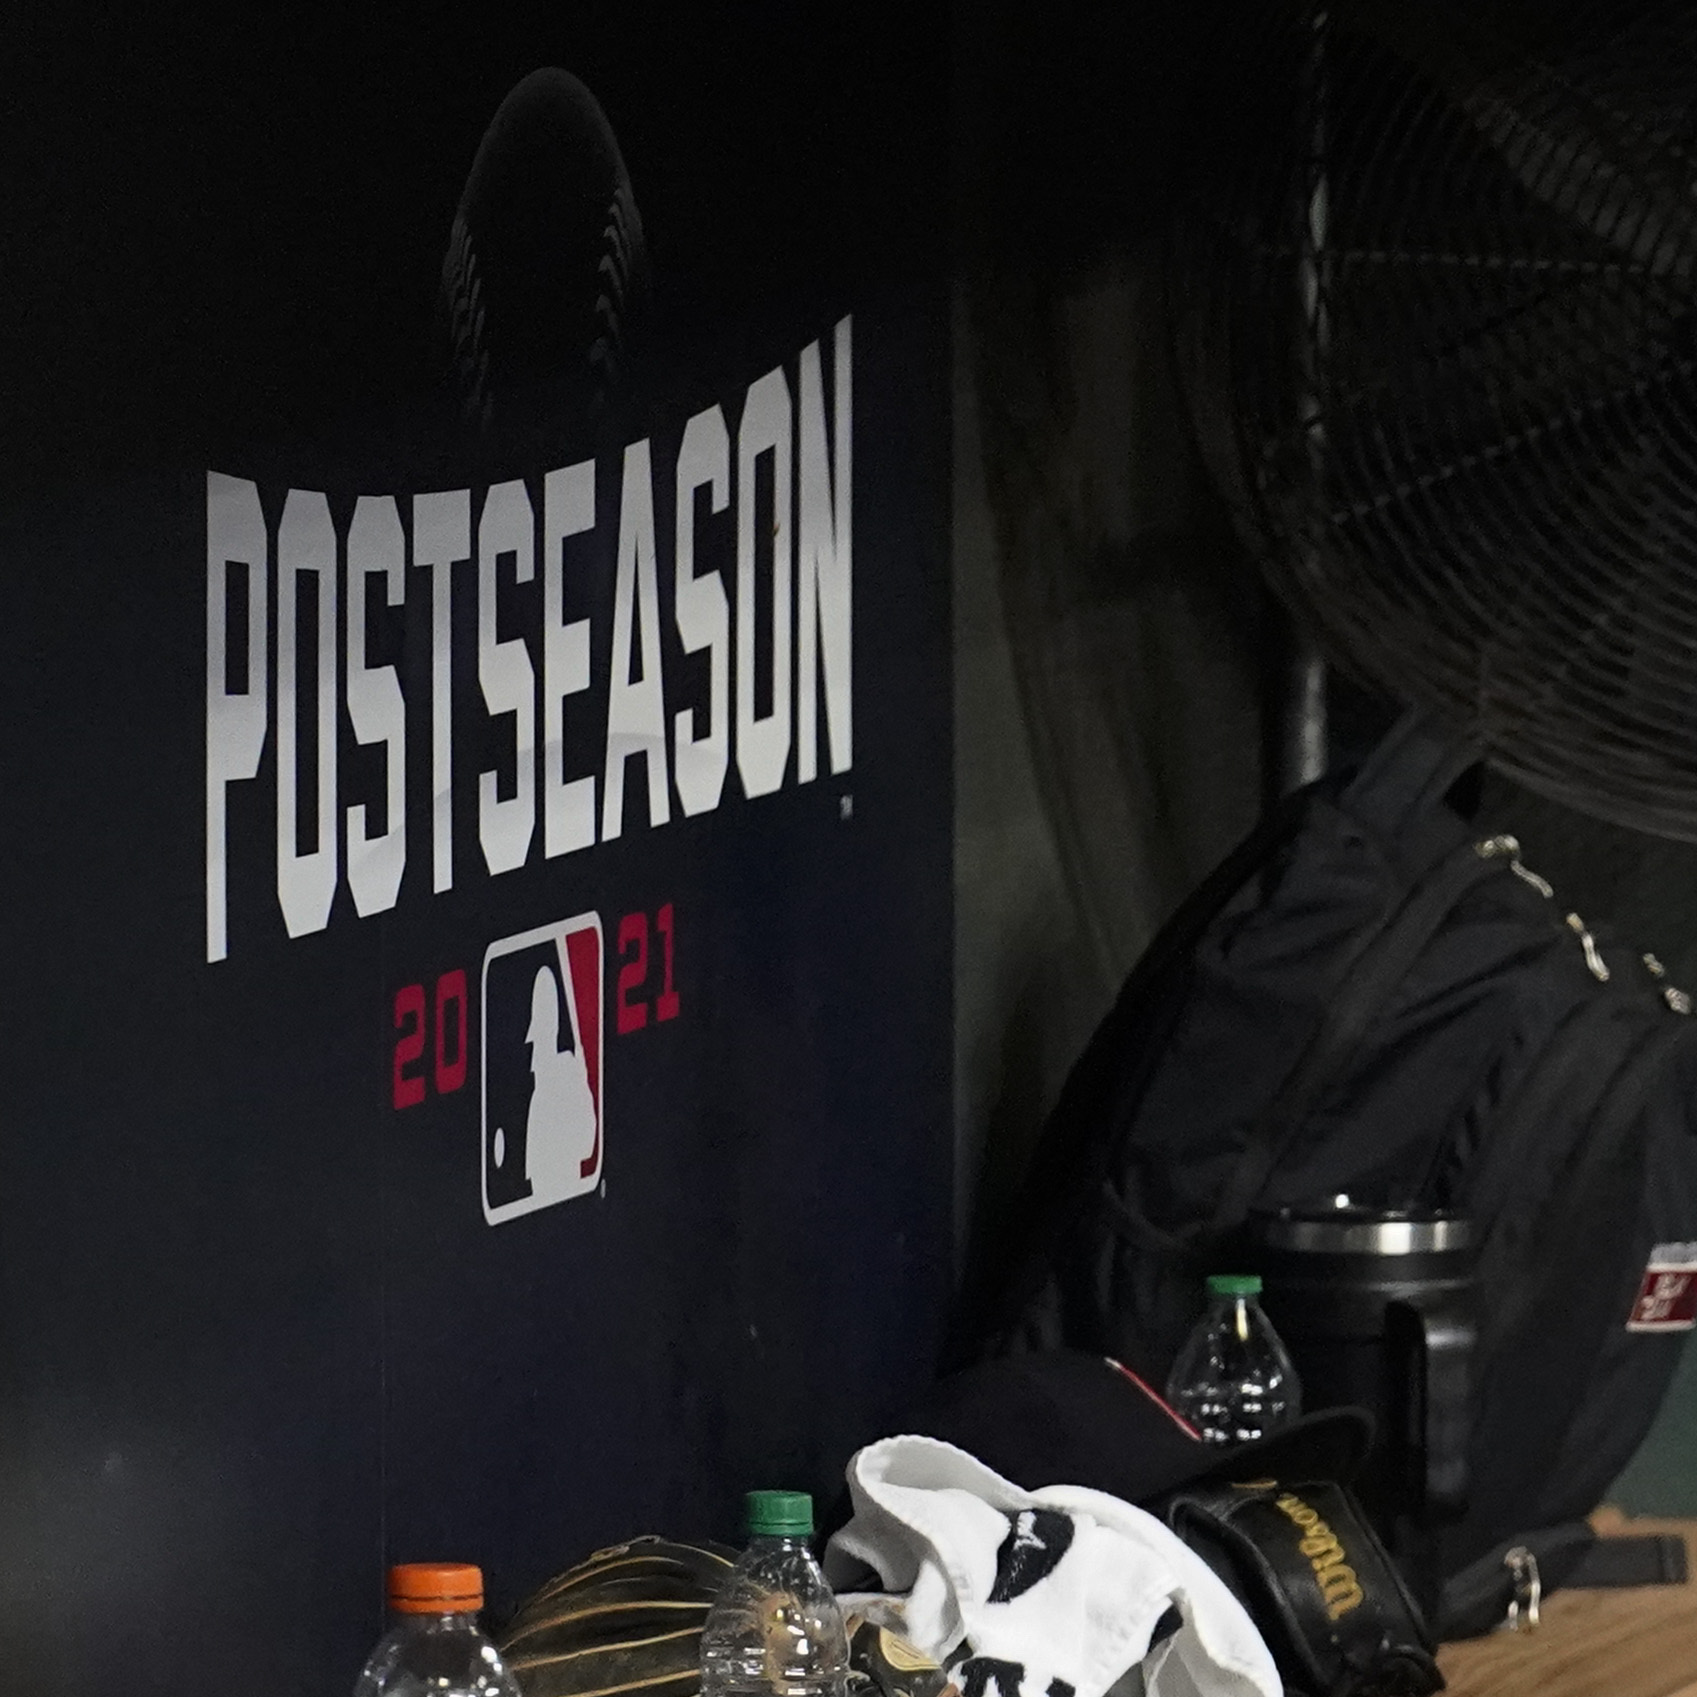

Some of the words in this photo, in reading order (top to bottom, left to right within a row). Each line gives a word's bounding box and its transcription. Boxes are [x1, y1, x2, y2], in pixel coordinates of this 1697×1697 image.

[206, 312, 853, 964] POSTSEASON
[392, 968, 467, 1110] 20
[617, 902, 681, 1035] 21
[1275, 1492, 1365, 1622] Wilson
